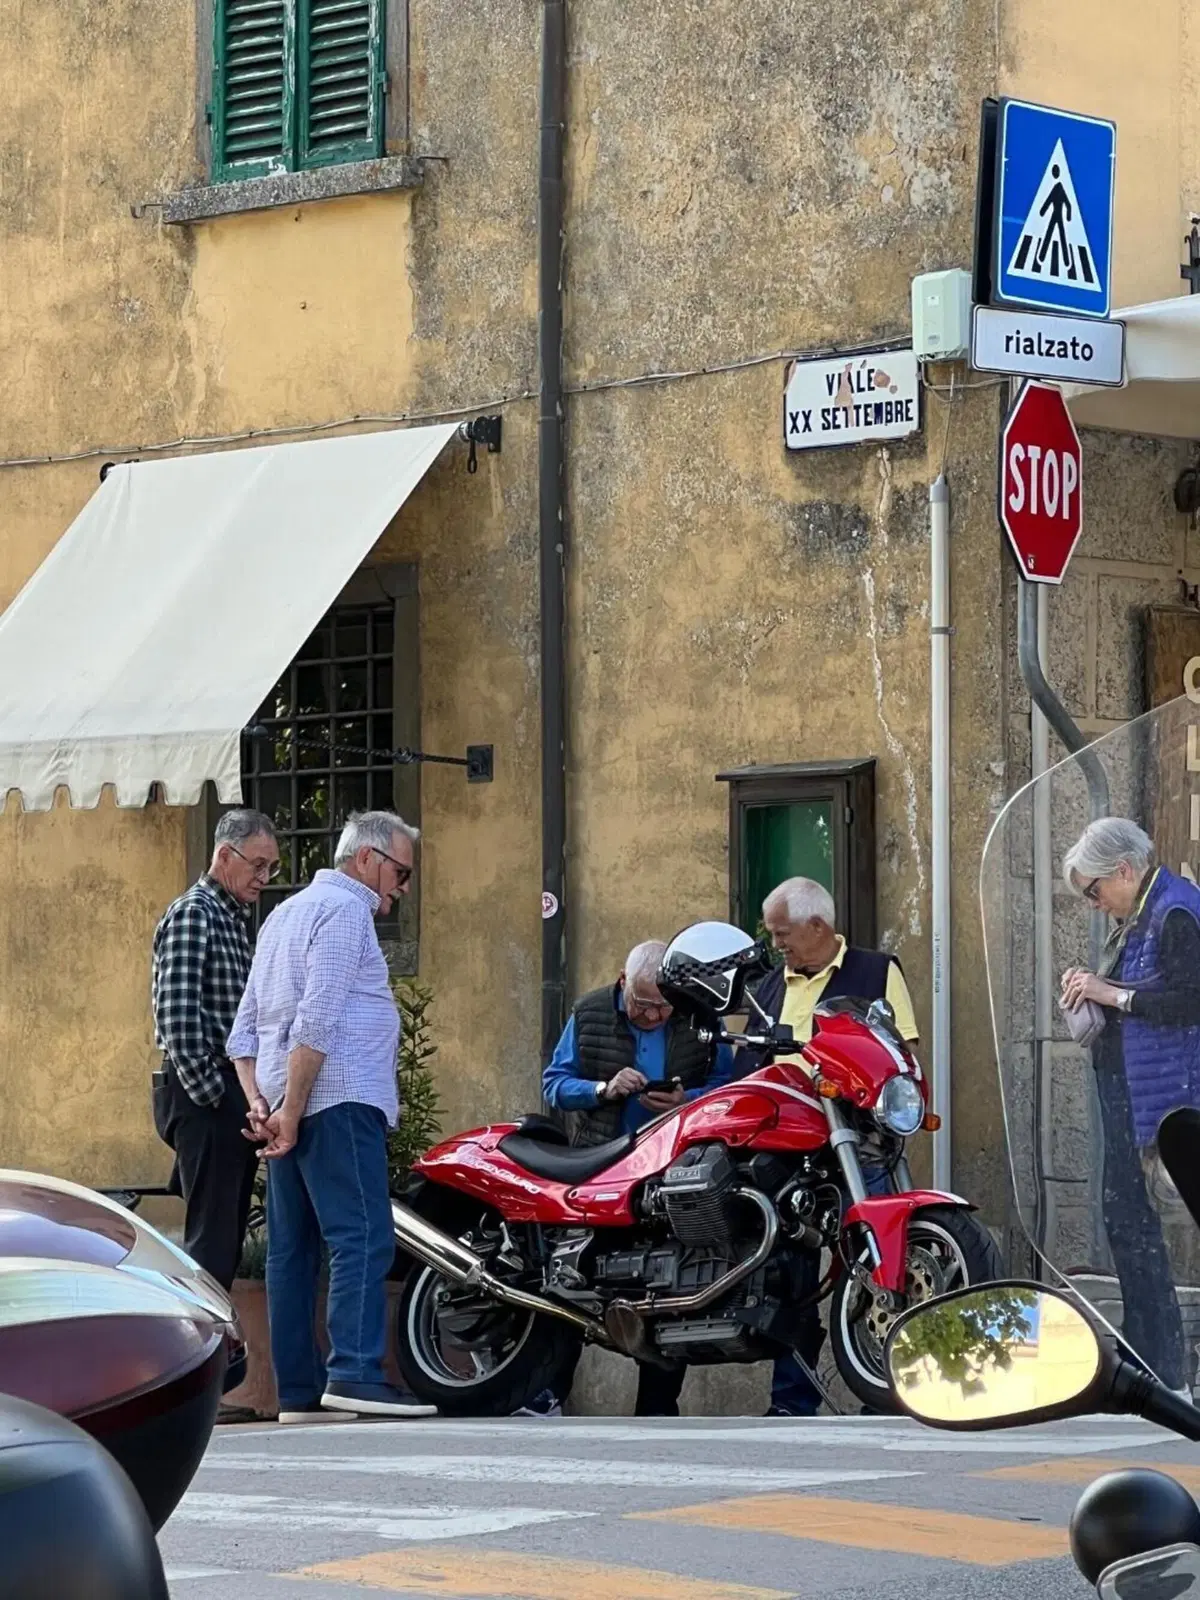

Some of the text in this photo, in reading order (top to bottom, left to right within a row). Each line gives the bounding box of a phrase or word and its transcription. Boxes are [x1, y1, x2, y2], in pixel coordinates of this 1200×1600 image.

[1004, 329, 1094, 362] rialzato
[789, 398, 914, 434] XX SETTEMBRE
[1009, 442, 1078, 520] STOP
